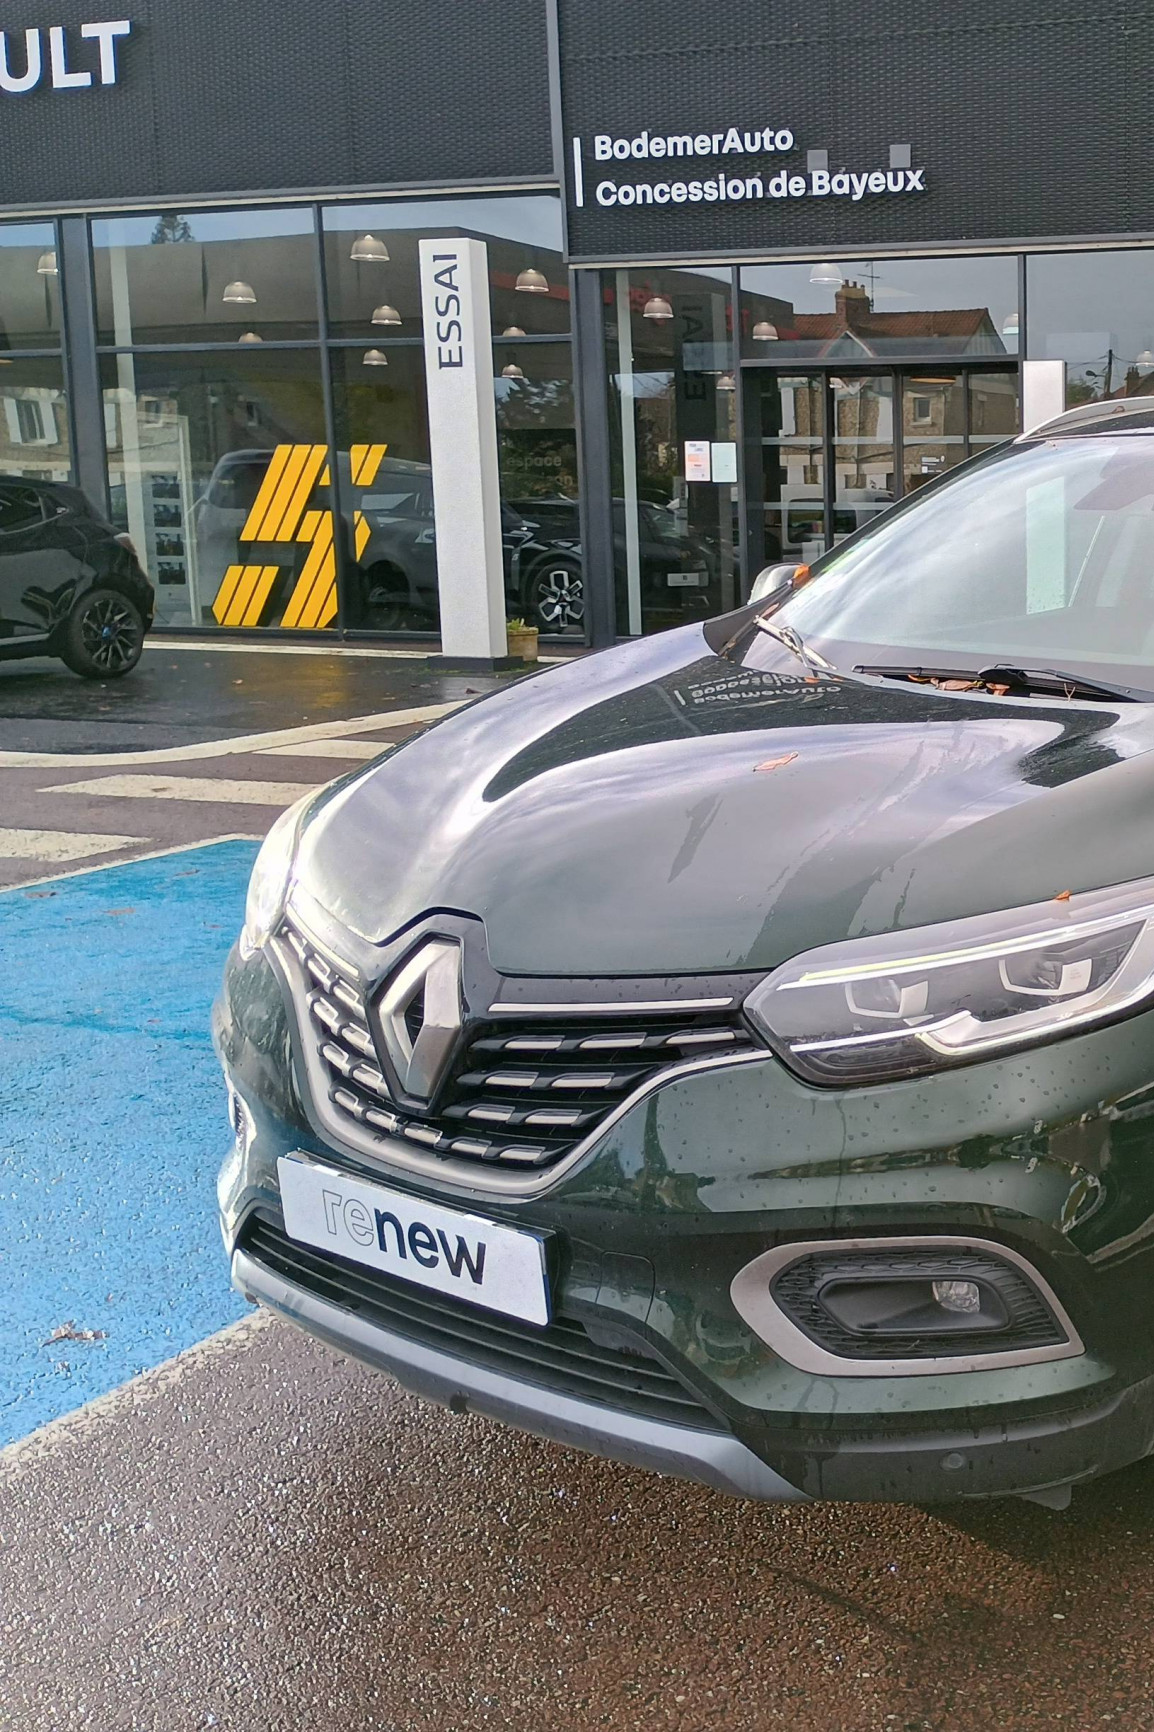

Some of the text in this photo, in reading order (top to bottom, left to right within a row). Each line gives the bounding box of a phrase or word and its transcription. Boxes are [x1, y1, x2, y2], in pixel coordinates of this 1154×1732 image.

[0, 20, 131, 93] ULT
[594, 127, 794, 160] BodemerAuto
[596, 168, 925, 206] Concession de Bayeux
[432, 254, 463, 370] ESSAI
[322, 1189, 487, 1285] renew
